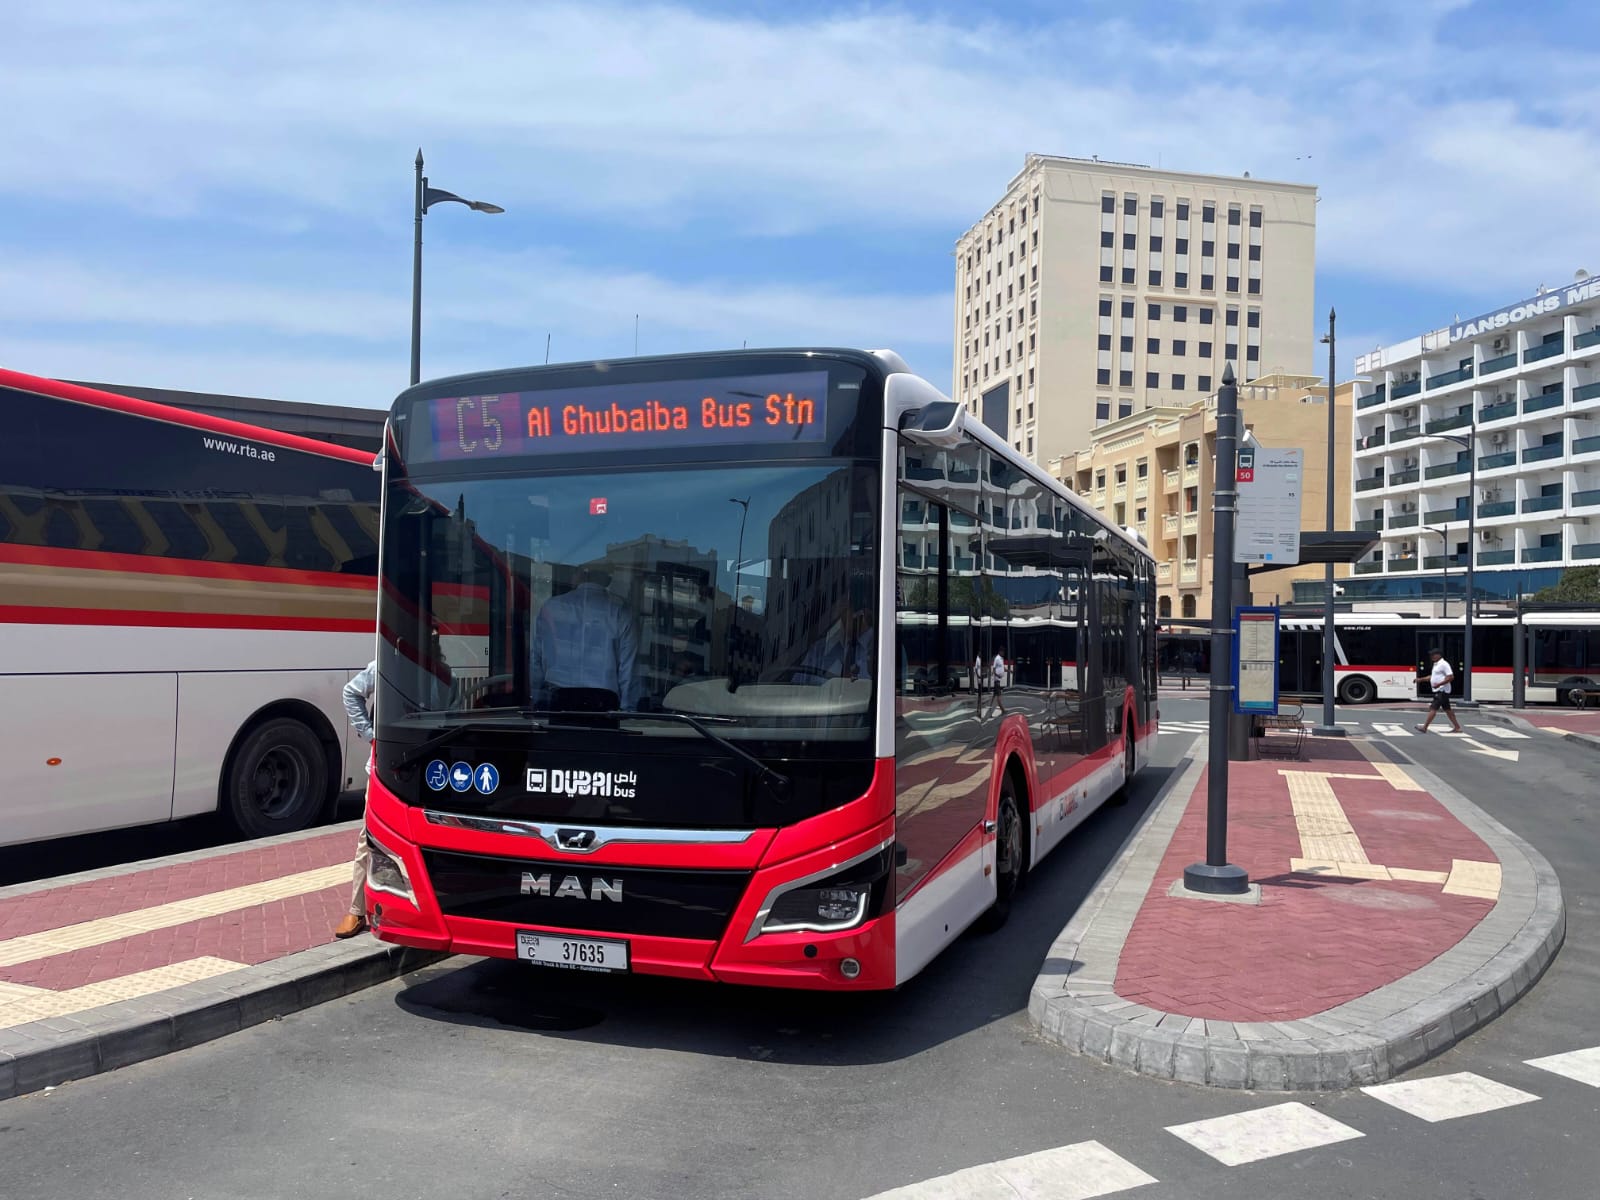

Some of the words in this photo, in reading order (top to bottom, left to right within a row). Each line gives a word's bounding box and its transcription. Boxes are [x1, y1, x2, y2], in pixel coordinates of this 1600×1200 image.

[1450, 295, 1560, 342] JANSONS
[456, 395, 503, 452] C5
[528, 407, 551, 437] Al
[562, 401, 689, 436] Ghubaiba
[702, 397, 752, 428] Bus
[765, 393, 814, 426] Stn
[203, 437, 276, 462] www.rta.ae
[1240, 472, 1251, 480] 50
[551, 769, 612, 798] DUBAI
[613, 785, 636, 798] bus
[520, 871, 624, 903] MAN
[527, 946, 536, 958] C
[562, 942, 604, 964] 37635
